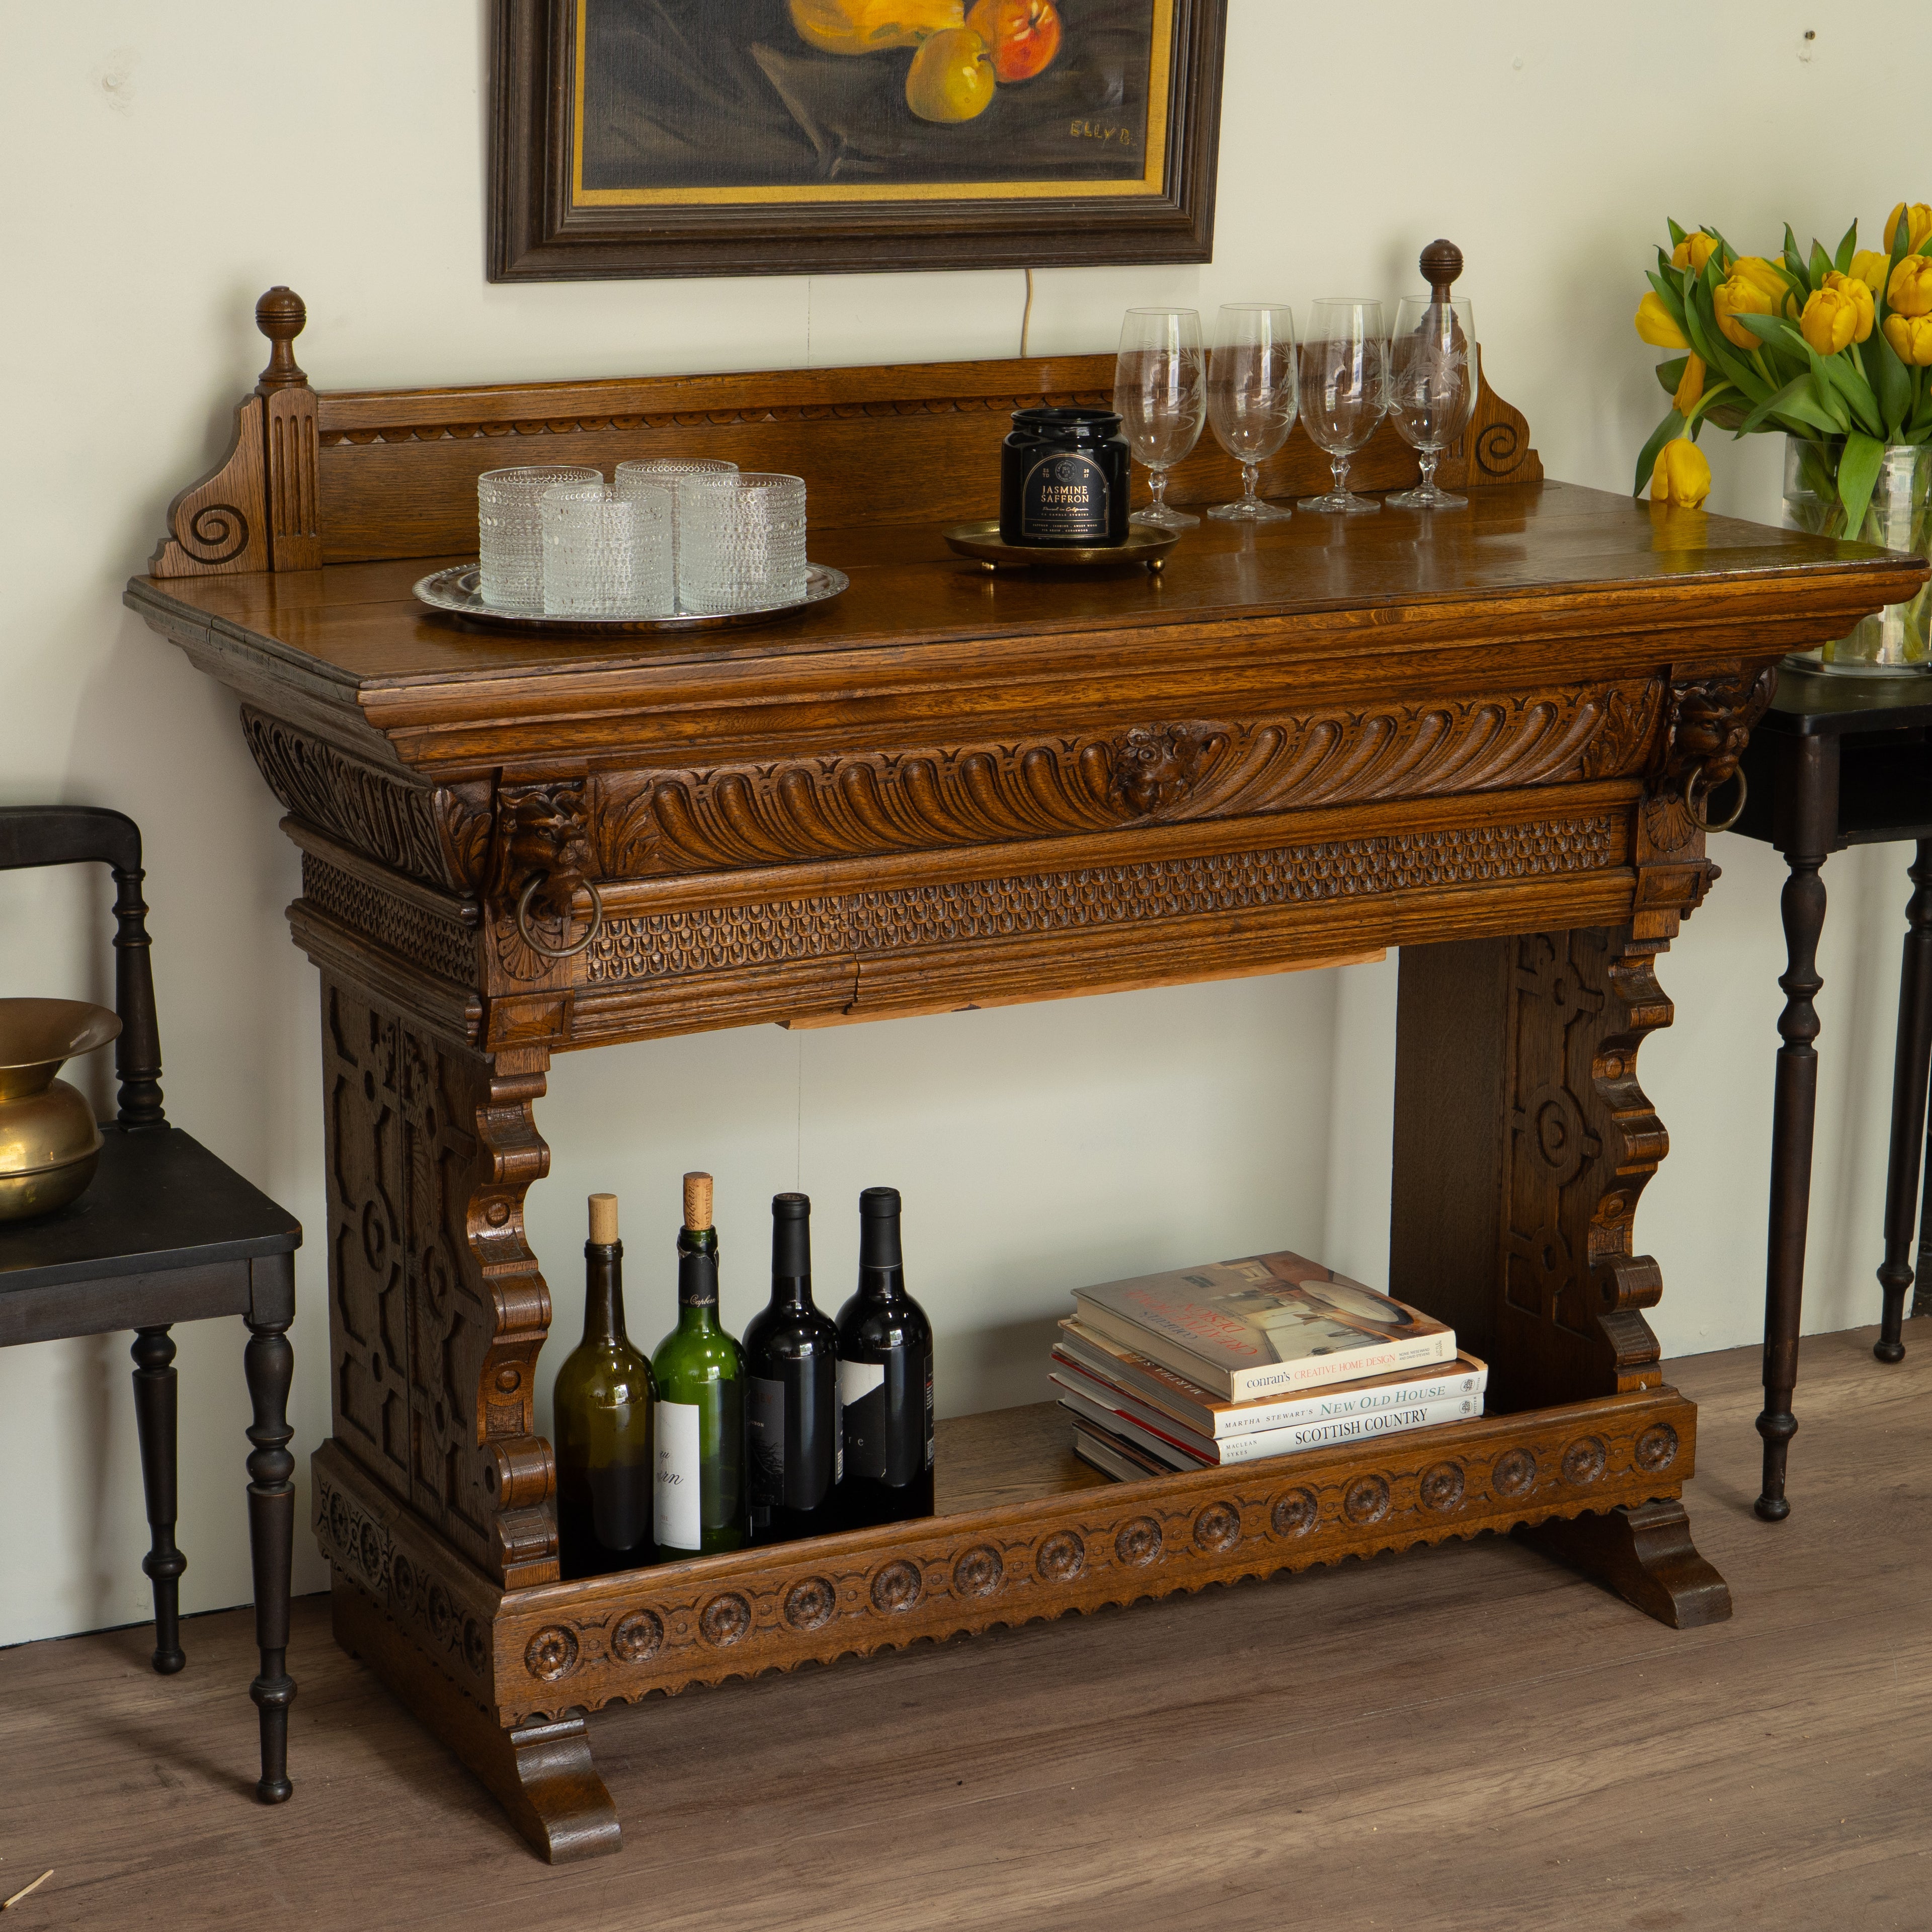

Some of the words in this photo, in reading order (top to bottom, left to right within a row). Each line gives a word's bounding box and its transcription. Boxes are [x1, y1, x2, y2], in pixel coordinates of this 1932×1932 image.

[1070, 120, 1116, 149] ELLY
[1041, 495, 1089, 503] SAFFRON
[1042, 486, 1088, 494] JASMINE
[690, 1294, 716, 1308] Capbern
[1170, 1313, 1257, 1355] CREATIVE
[1155, 1368, 1205, 1395] MARTHA
[1246, 1372, 1291, 1389] conran's
[1294, 1364, 1337, 1380] CREATIVE
[1339, 1359, 1364, 1372] HOME
[1366, 1353, 1396, 1367] DESIGN
[1224, 1417, 1261, 1429] MARTHA
[1265, 1409, 1314, 1422] STEWART'S
[1320, 1400, 1356, 1416] NEW
[1359, 1395, 1391, 1409] OLD
[1394, 1386, 1446, 1403] HOUSE
[1295, 1420, 1361, 1445] SCOTTISH
[1364, 1408, 1428, 1431] COUNTRY
[1226, 1439, 1258, 1450] MACLEAN
[1227, 1450, 1248, 1458] SYKES
